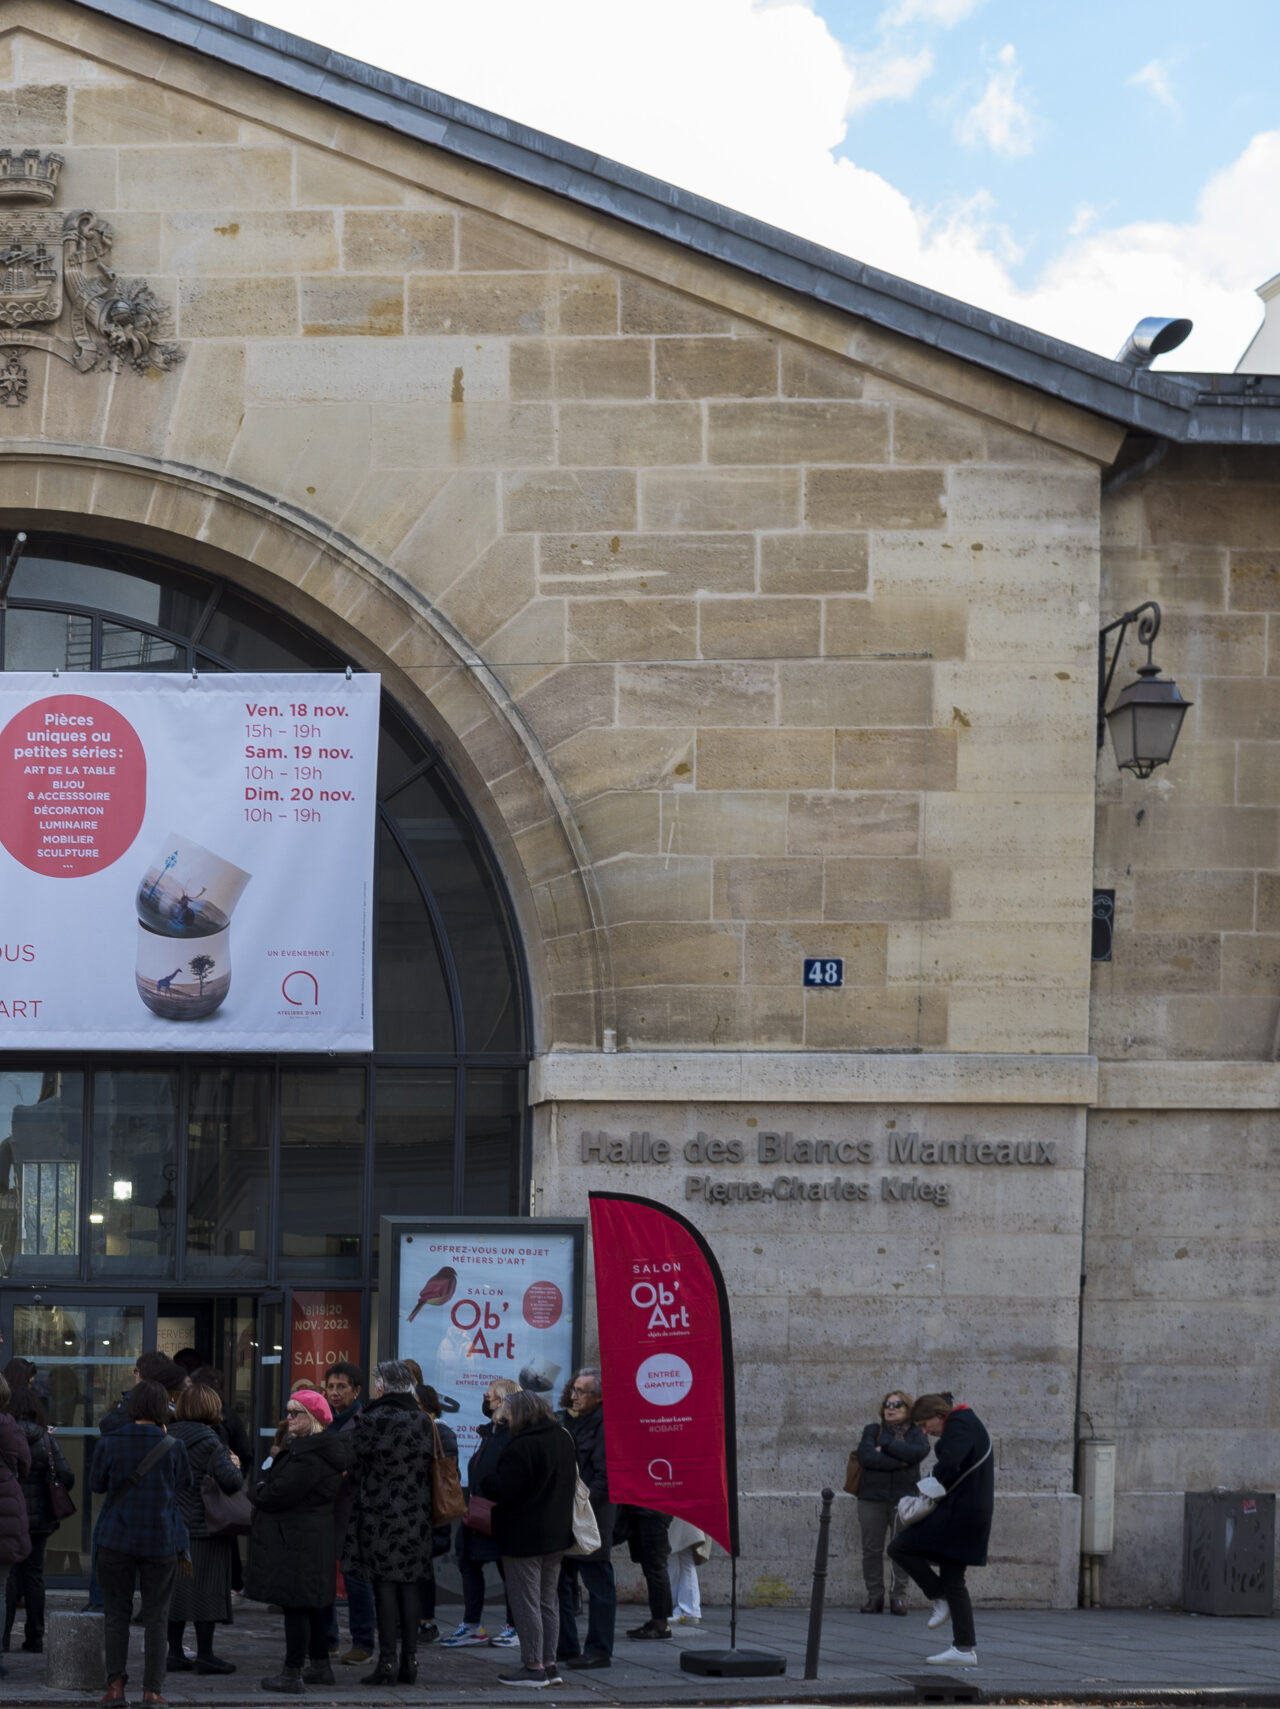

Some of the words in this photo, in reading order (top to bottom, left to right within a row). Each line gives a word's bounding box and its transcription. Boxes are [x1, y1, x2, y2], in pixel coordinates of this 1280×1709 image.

[245, 703, 283, 717] Ven.
[290, 703, 307, 717] 18
[314, 706, 349, 717] nov.
[45, 713, 94, 726] Pièces
[27, 730, 87, 744] uniques
[91, 732, 111, 742] ou
[245, 724, 273, 738] 15h
[293, 724, 321, 738] 19h
[14, 746, 68, 760] petites
[245, 745, 288, 759] Sam.
[294, 746, 312, 759] 19
[319, 748, 354, 759] nov.
[24, 766, 45, 775] ART
[48, 766, 62, 775] DE
[65, 766, 79, 775] LA
[82, 766, 116, 775] TABLE
[245, 766, 273, 780] 10h
[294, 766, 322, 780] 19h
[52, 780, 85, 789] BIJOU
[27, 792, 35, 800] &
[245, 787, 284, 801] Dim.
[290, 788, 313, 801] 20
[320, 790, 355, 801] nov.
[34, 804, 104, 815] DÉCORATION
[244, 808, 273, 822] 10h
[293, 808, 321, 822] 19h
[40, 821, 98, 830] LUMINAIRE
[43, 835, 94, 844] MOBILIER
[37, 849, 99, 858] SCULPTURE
[808, 962, 838, 984] 48
[580, 1131, 671, 1164] Halle
[684, 1132, 744, 1164] des
[758, 1132, 873, 1164] Blancs
[888, 1132, 1057, 1166] Manteaux
[684, 1175, 871, 1202] Pierre-Charles
[881, 1176, 952, 1206] Krieg
[429, 1245, 498, 1255] OFFREZ-VOUS
[501, 1247, 515, 1255] UN
[518, 1248, 550, 1257] OBJET
[452, 1254, 494, 1264] MÉTIERS
[497, 1257, 526, 1265] D'ART
[633, 1262, 681, 1274] SALON
[467, 1288, 504, 1296] SALON
[648, 1304, 690, 1329] Art
[295, 1320, 321, 1331] NOV.
[323, 1319, 349, 1330] 2022
[466, 1327, 515, 1359] Art
[294, 1350, 349, 1365] SALON
[648, 1368, 680, 1379] ENTRÉE
[644, 1381, 685, 1389] GRATUITE
[456, 1425, 468, 1433] 20
[648, 1424, 684, 1433] #OBART
